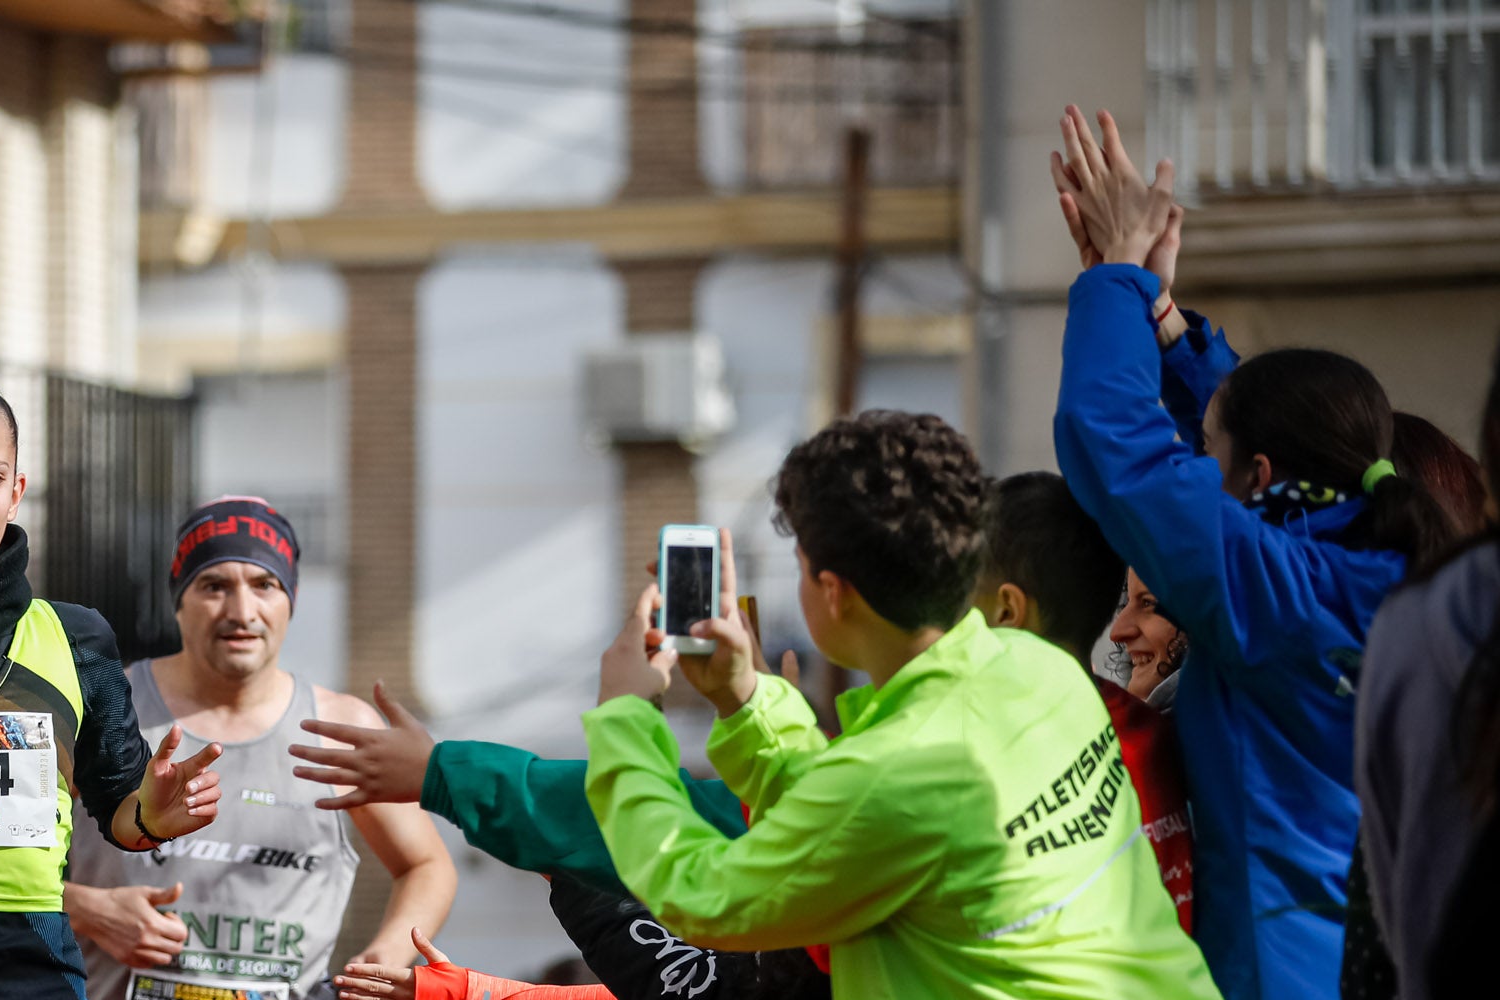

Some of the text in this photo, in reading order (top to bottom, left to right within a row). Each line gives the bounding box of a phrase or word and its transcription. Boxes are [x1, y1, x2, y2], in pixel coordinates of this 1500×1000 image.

[1004, 722, 1117, 839] ATLETISMO
[170, 910, 305, 958] NTER
[216, 958, 236, 974] DE
[238, 960, 300, 981] SEGUROS
